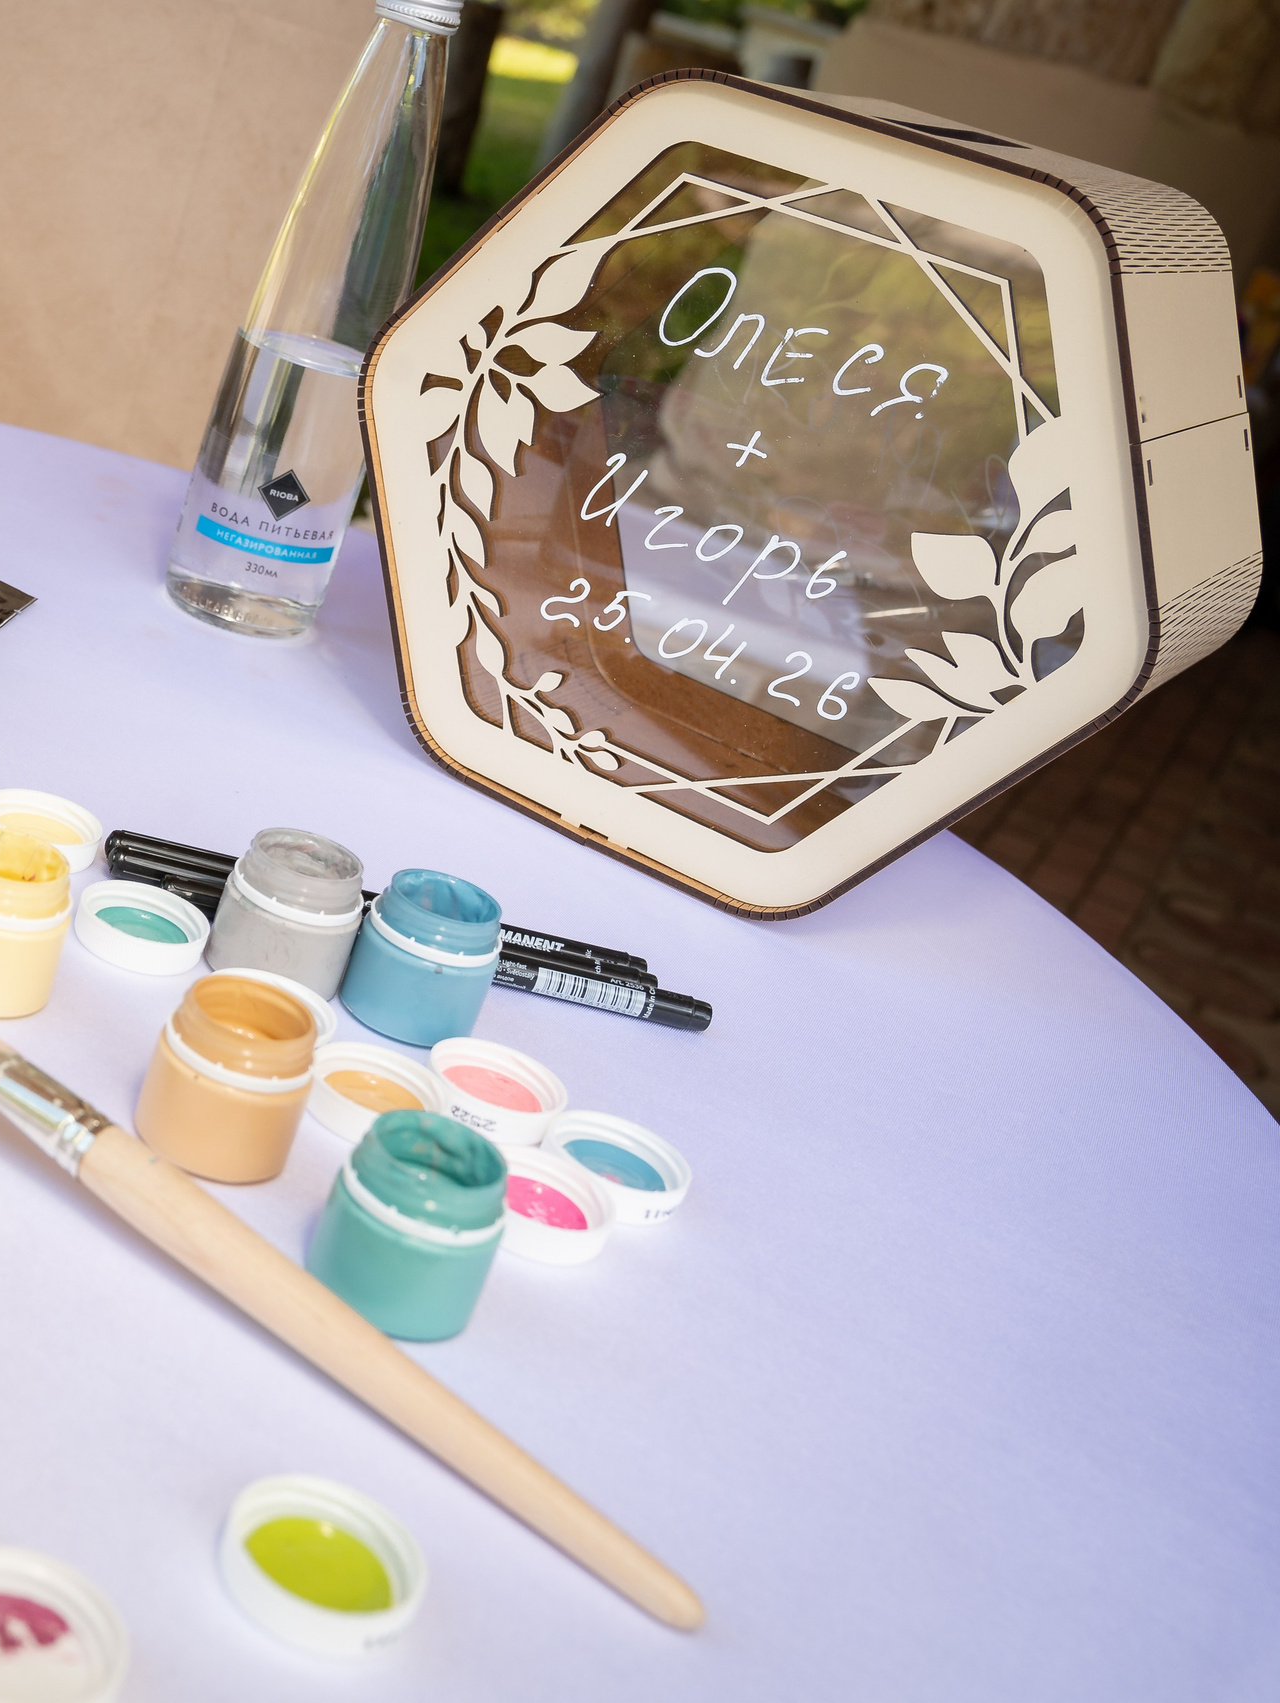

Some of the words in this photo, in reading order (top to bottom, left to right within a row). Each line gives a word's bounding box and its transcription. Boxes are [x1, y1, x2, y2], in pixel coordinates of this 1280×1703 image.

[269, 488, 300, 502] RIOBA
[211, 502, 250, 526] ВОДА
[258, 520, 334, 541] ПИТЬЕВАЯ
[581, 453, 847, 606] Игорь
[216, 529, 318, 559] НЕГАЗИРОВАННАЯ
[245, 561, 278, 578] 330мл
[500, 929, 565, 952] MANENT
